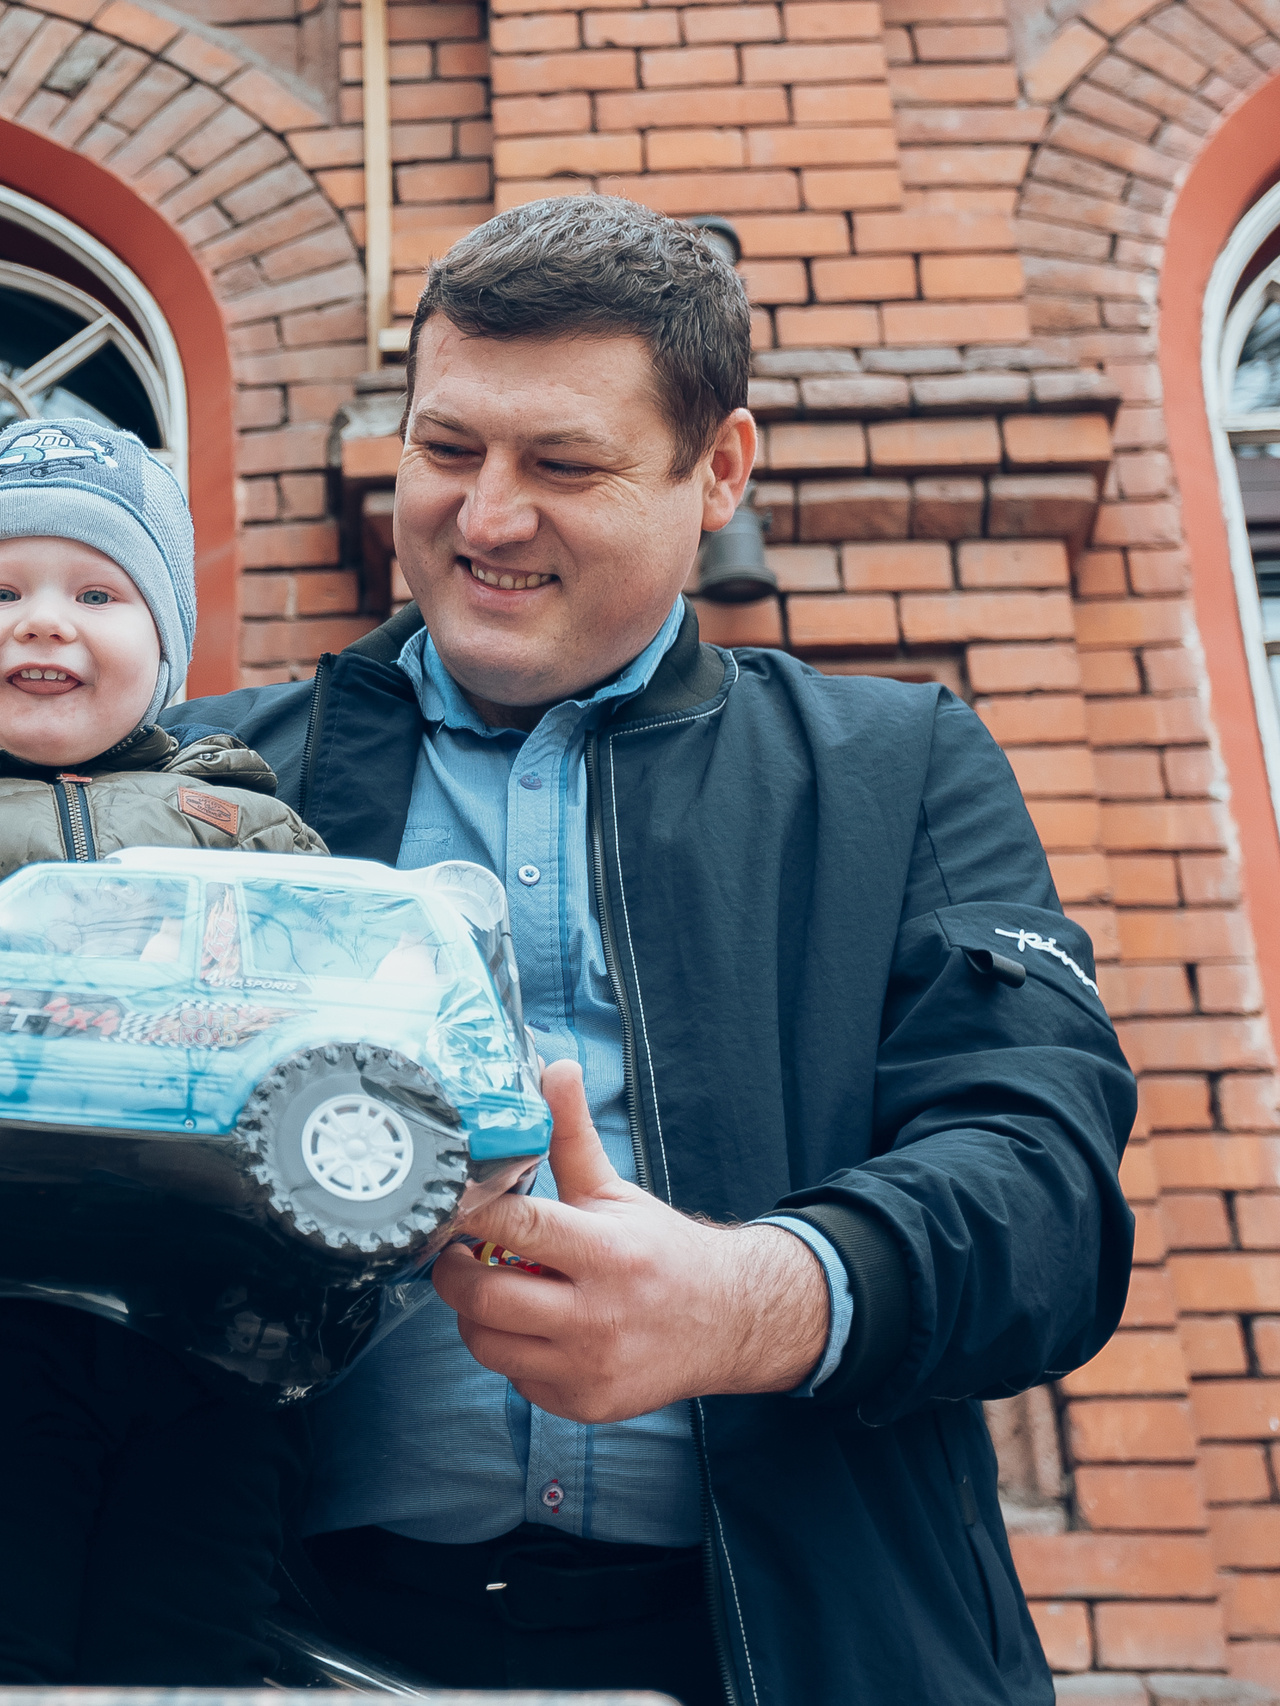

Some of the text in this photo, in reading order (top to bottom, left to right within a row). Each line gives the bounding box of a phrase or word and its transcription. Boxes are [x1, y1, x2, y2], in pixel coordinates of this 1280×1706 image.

[242, 977, 298, 992] SPORTS
[180, 1008, 238, 1028] OFF
[180, 1026, 238, 1047] ROAD
